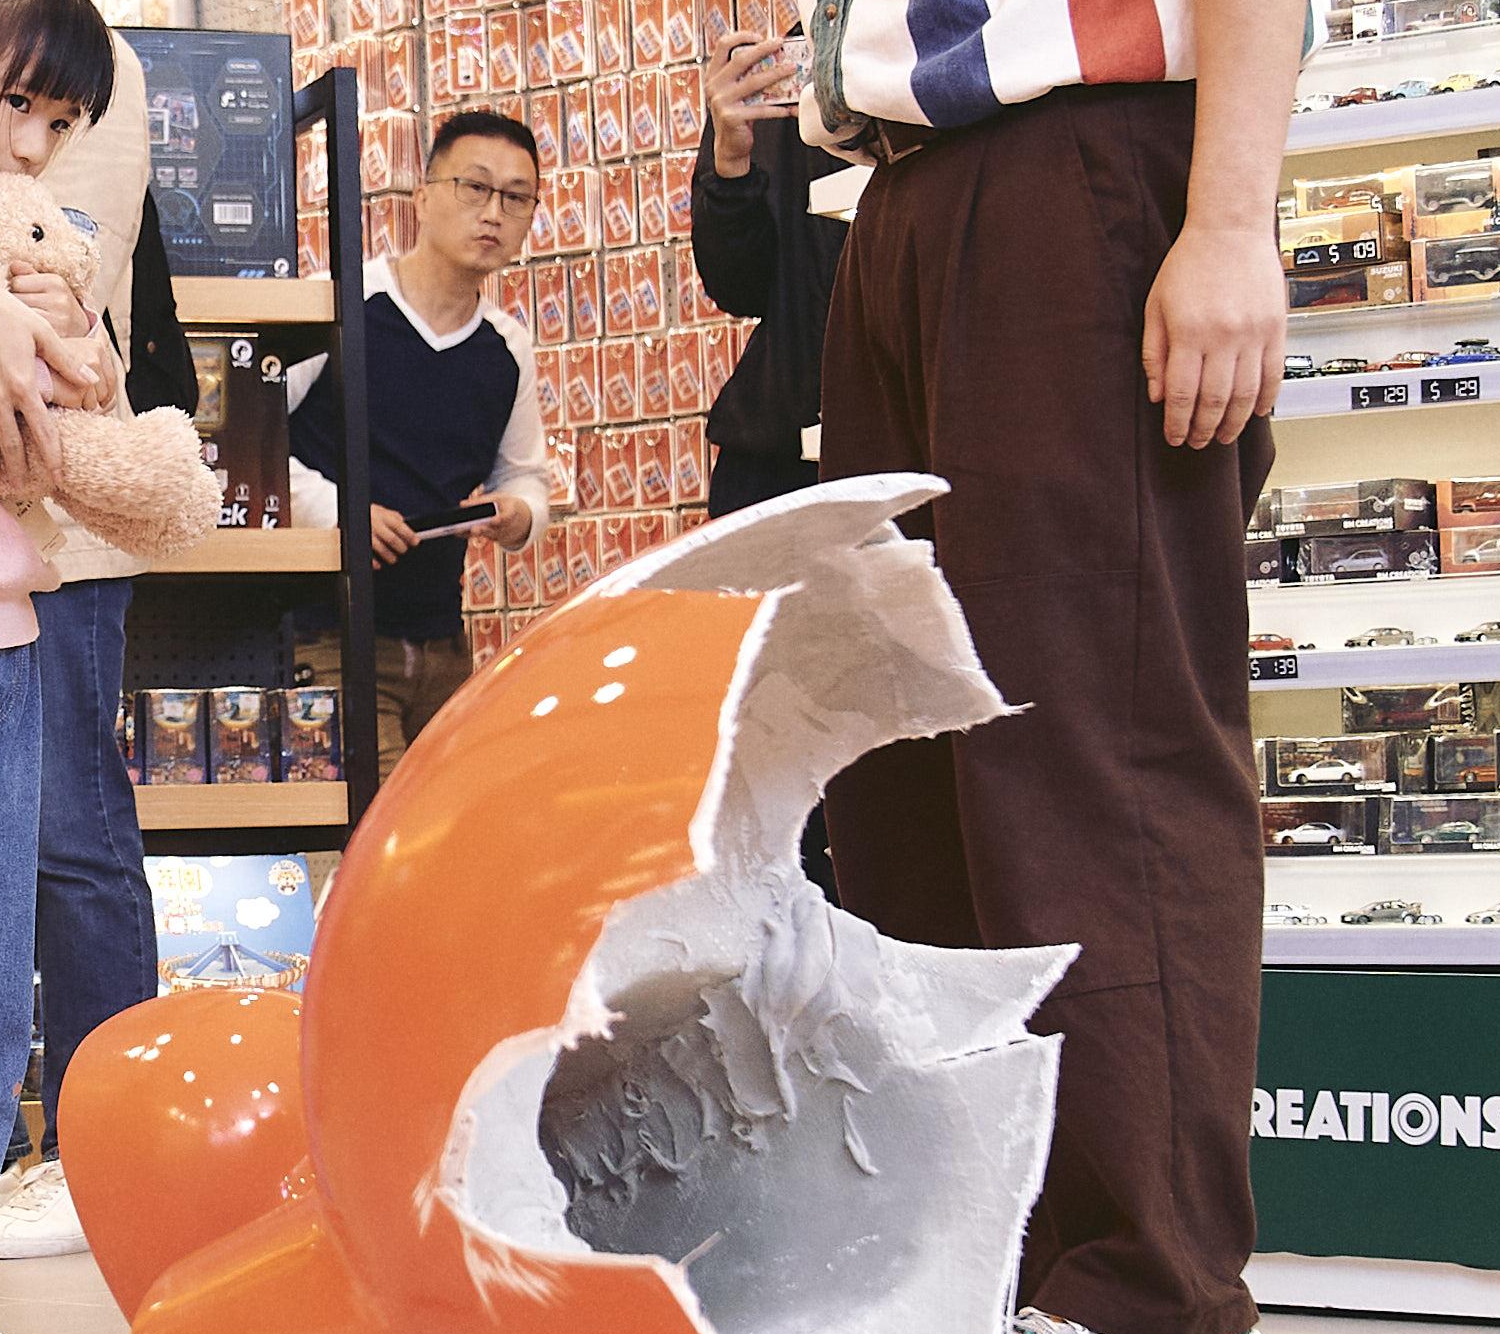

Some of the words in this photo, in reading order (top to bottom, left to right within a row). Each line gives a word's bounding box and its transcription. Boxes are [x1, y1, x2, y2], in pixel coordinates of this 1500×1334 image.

[1329, 245, 1341, 265] $
[1353, 241, 1375, 259] 109
[1359, 387, 1370, 407] $
[1383, 386, 1407, 402] 129
[1430, 381, 1441, 401] $
[1455, 379, 1479, 396] 129
[217, 504, 249, 526] ck
[1250, 659, 1261, 679] $
[1273, 658, 1296, 675] 139
